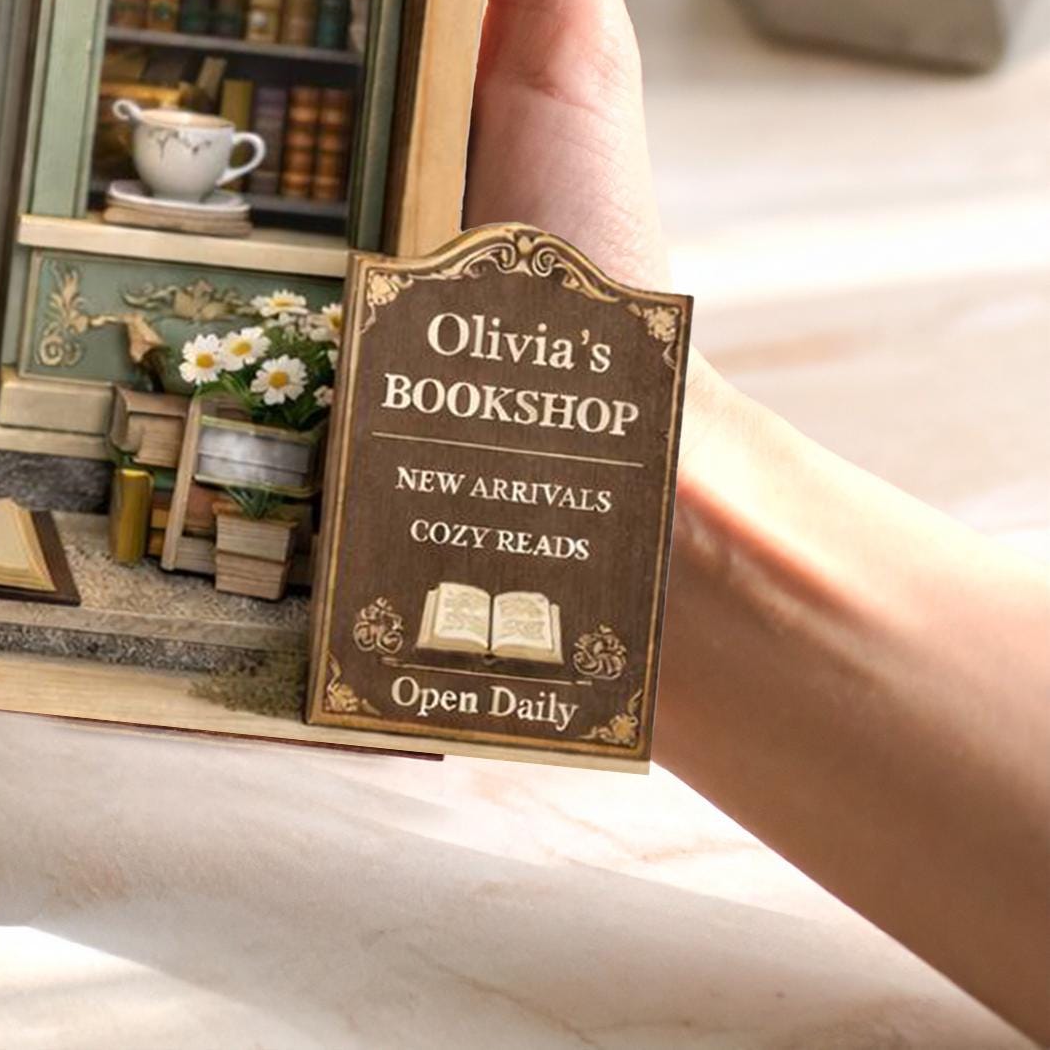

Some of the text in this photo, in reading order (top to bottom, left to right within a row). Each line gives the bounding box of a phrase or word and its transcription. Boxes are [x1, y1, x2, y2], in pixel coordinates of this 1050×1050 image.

[427, 312, 612, 373] Olivia's
[380, 373, 639, 437] BOOKSHOP
[395, 466, 612, 513] NEW ARRIVALS
[410, 519, 590, 560] COZY READS
[390, 676, 580, 731] Open Daily
